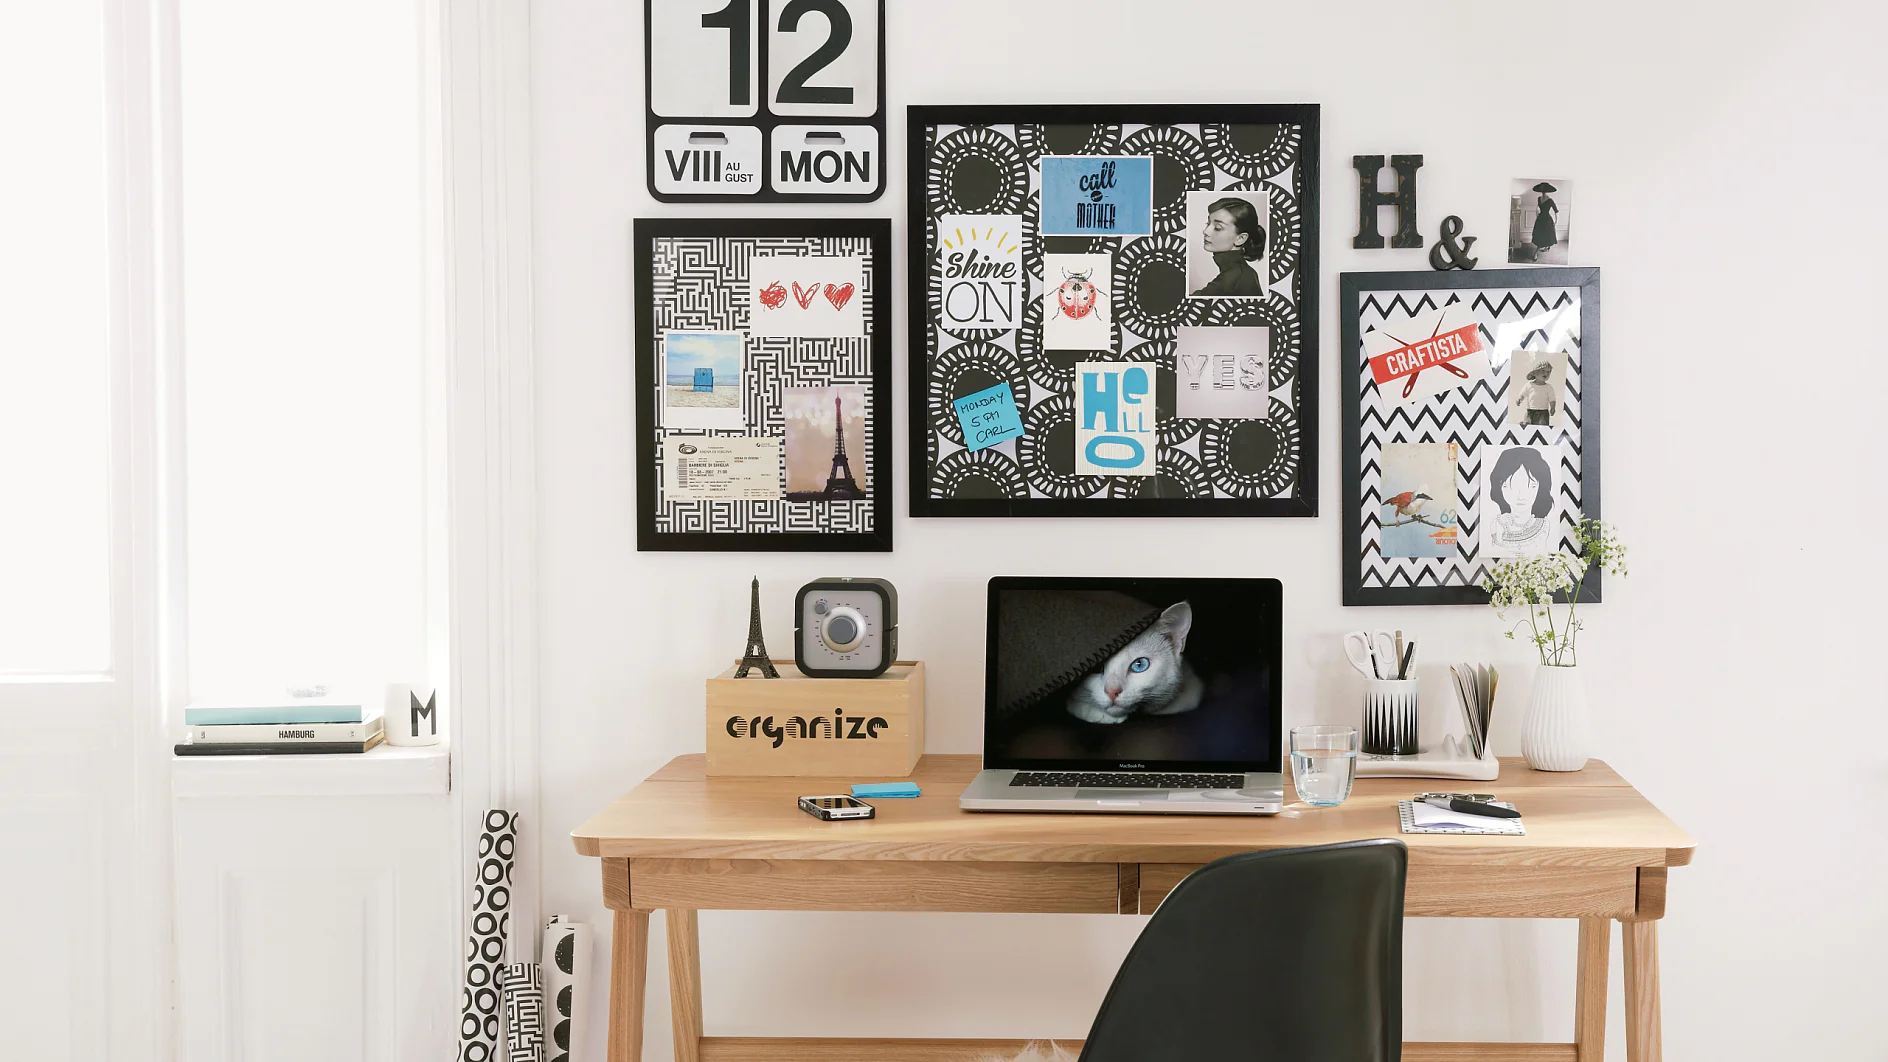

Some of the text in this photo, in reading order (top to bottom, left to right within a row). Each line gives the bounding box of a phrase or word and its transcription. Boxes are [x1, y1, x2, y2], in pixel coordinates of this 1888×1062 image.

[665, 149, 721, 182] VIII
[725, 162, 741, 171] AU
[725, 173, 753, 182] GUST
[780, 150, 870, 183] MON
[1079, 160, 1118, 192] call
[1076, 202, 1116, 229] MOTHER
[1353, 154, 1424, 249] H
[945, 248, 1017, 279] Shine
[945, 281, 1017, 323] ON
[1386, 333, 1468, 375] CRAFTISTA
[1181, 354, 1265, 391] YES
[960, 392, 1004, 414] MONDAY
[971, 410, 1000, 428] 5 PM
[976, 425, 1017, 443] CARL
[1440, 509, 1457, 524] 62
[410, 688, 437, 737] M
[726, 707, 889, 749] organize
[278, 730, 315, 739] HAMBURG
